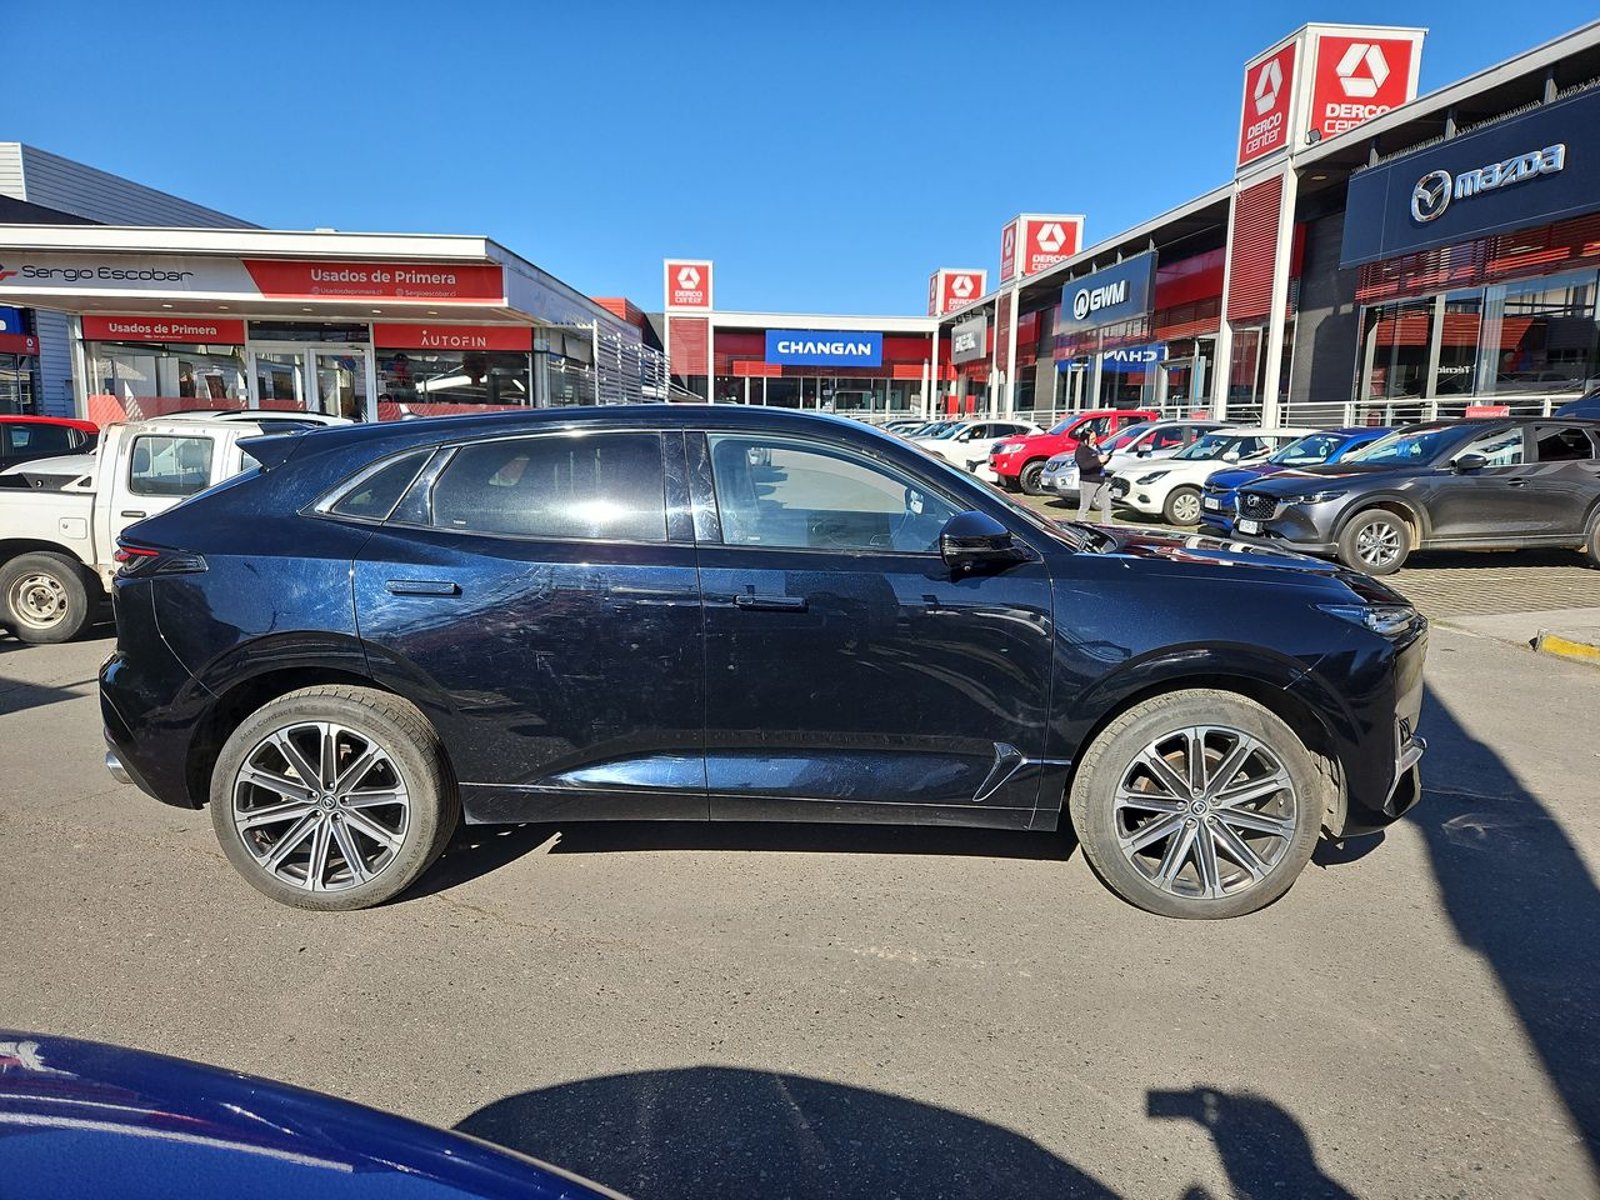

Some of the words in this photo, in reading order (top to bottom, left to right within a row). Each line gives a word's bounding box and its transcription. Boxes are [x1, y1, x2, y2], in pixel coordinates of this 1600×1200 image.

[1247, 112, 1282, 140] DERCO
[1324, 119, 1366, 133] cen
[1246, 127, 1281, 154] center
[22, 264, 94, 281] Sergio
[97, 266, 194, 282] Escobar
[311, 268, 367, 282] Usados
[371, 270, 391, 283] de
[395, 270, 456, 285] Primera
[1090, 280, 1126, 311] GWM
[109, 323, 151, 333] Usados
[154, 324, 169, 334] de
[171, 324, 217, 335] Primera
[421, 330, 486, 347] AUTOFIN
[777, 341, 872, 356] CHANGAN
